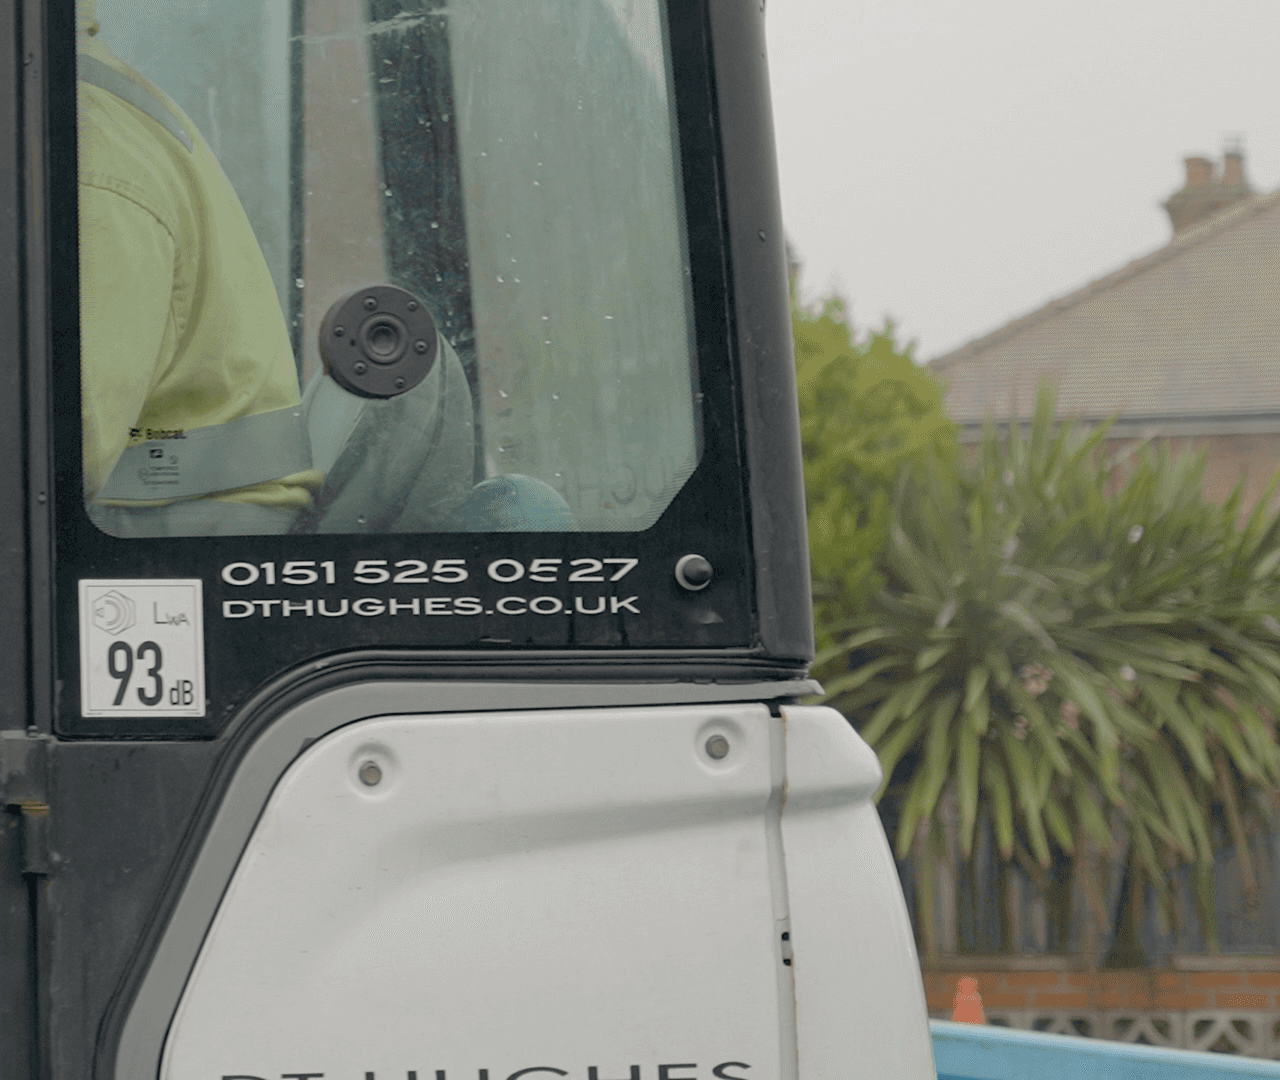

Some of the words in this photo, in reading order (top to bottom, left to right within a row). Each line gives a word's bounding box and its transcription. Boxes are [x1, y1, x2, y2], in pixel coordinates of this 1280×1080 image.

[221, 560, 336, 586] 0151
[353, 559, 469, 584] 525
[221, 596, 641, 619] DTHUGHES.CO.UK
[108, 640, 164, 707] 93
[169, 680, 194, 706] dB
